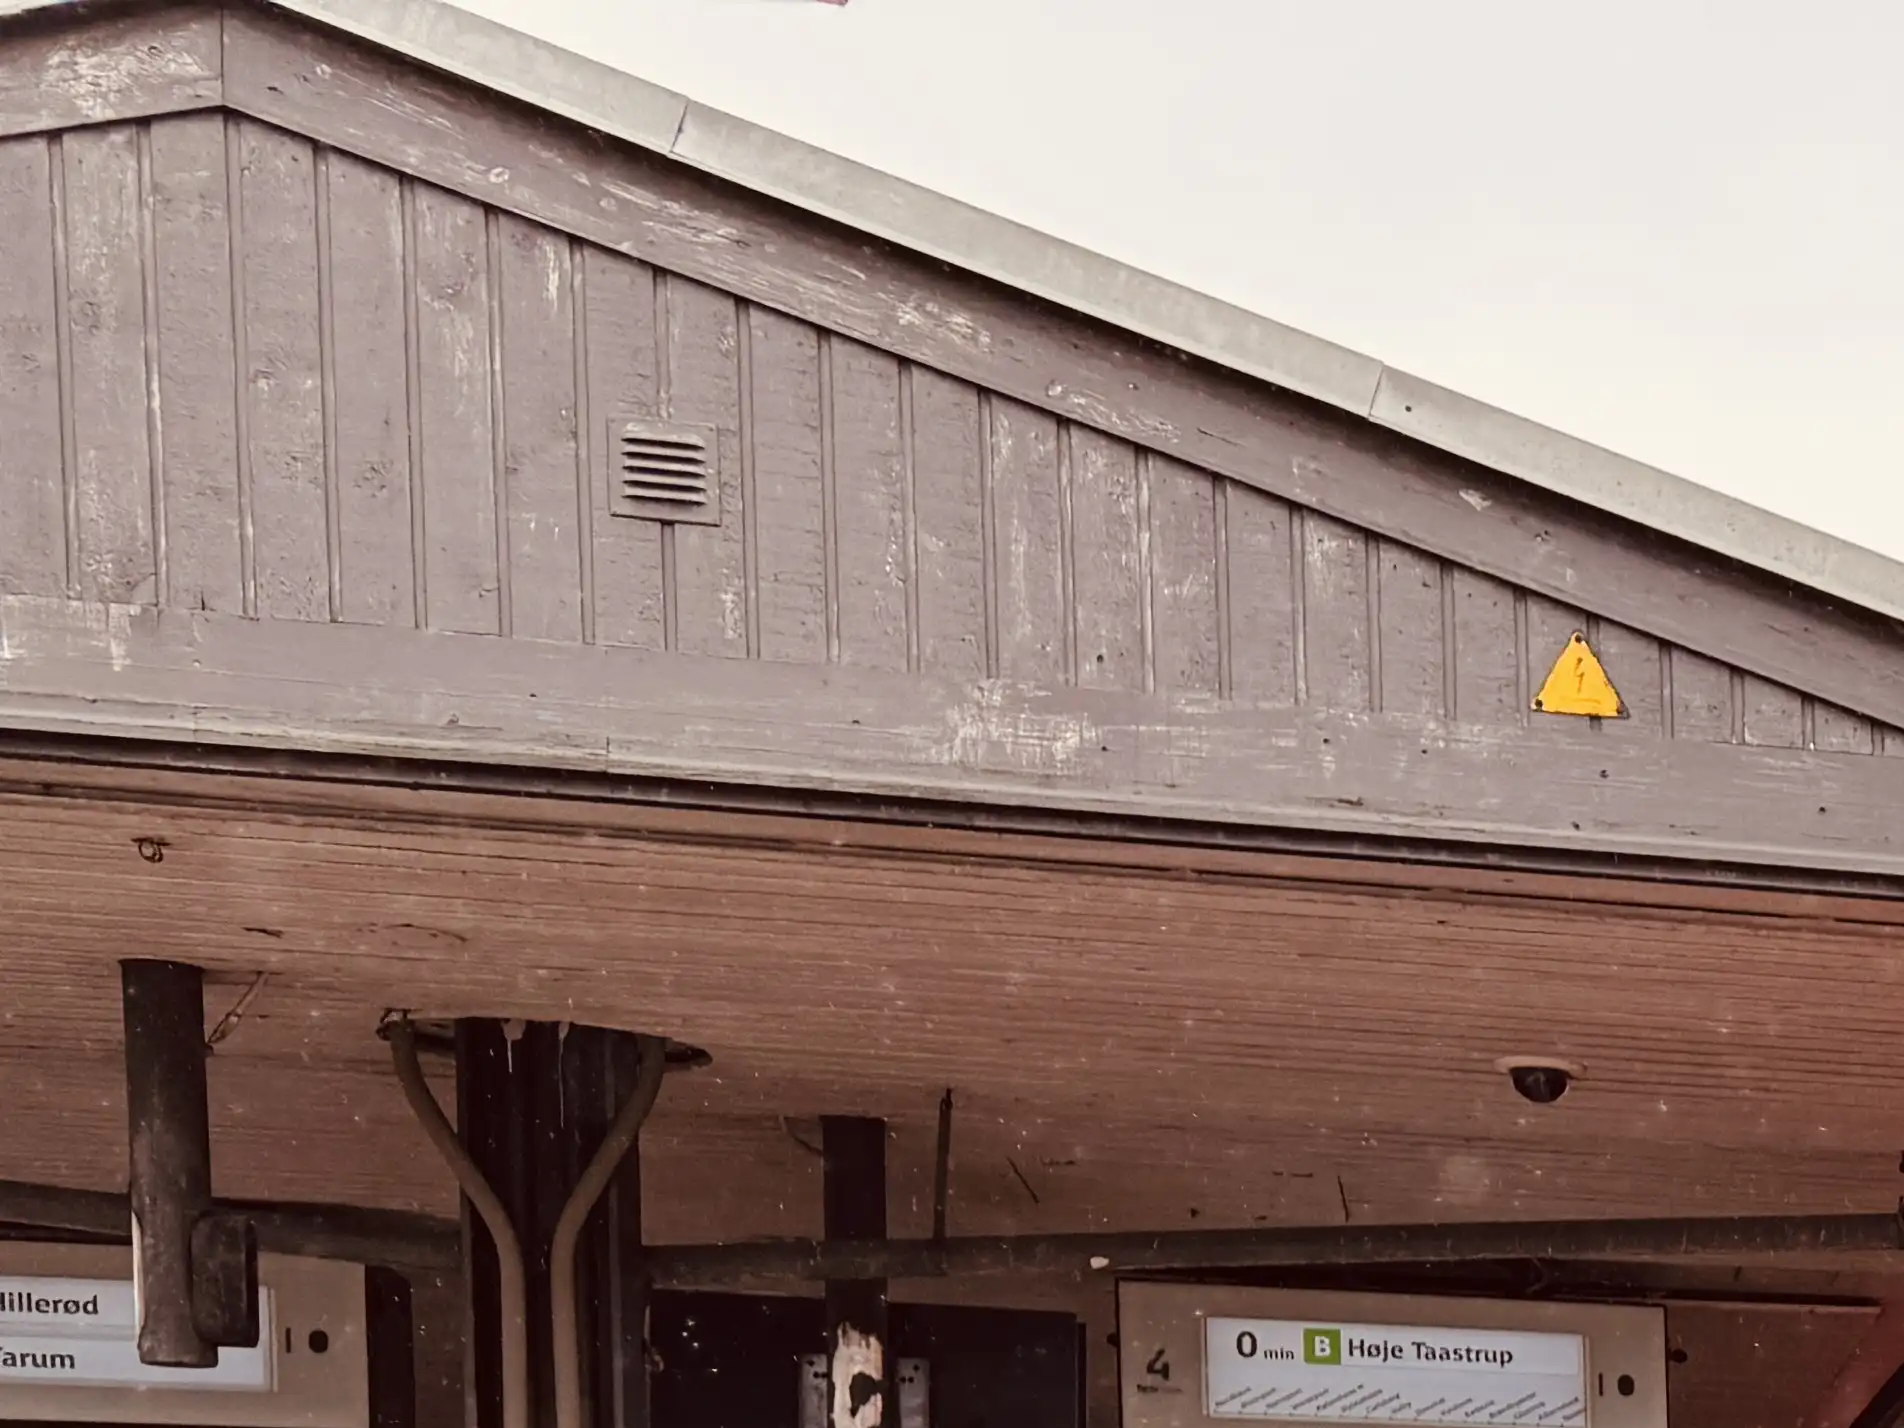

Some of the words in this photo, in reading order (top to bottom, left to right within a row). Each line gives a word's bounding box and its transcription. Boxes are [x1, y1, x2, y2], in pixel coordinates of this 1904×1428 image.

[0, 1346, 76, 1369] arum
[1146, 1348, 1170, 1381] 4
[1236, 1330, 1257, 1358] 0
[1263, 1346, 1295, 1361] min
[1314, 1335, 1331, 1357] B
[1348, 1338, 1404, 1363] Høje
[1411, 1341, 1514, 1369] Taastrup
